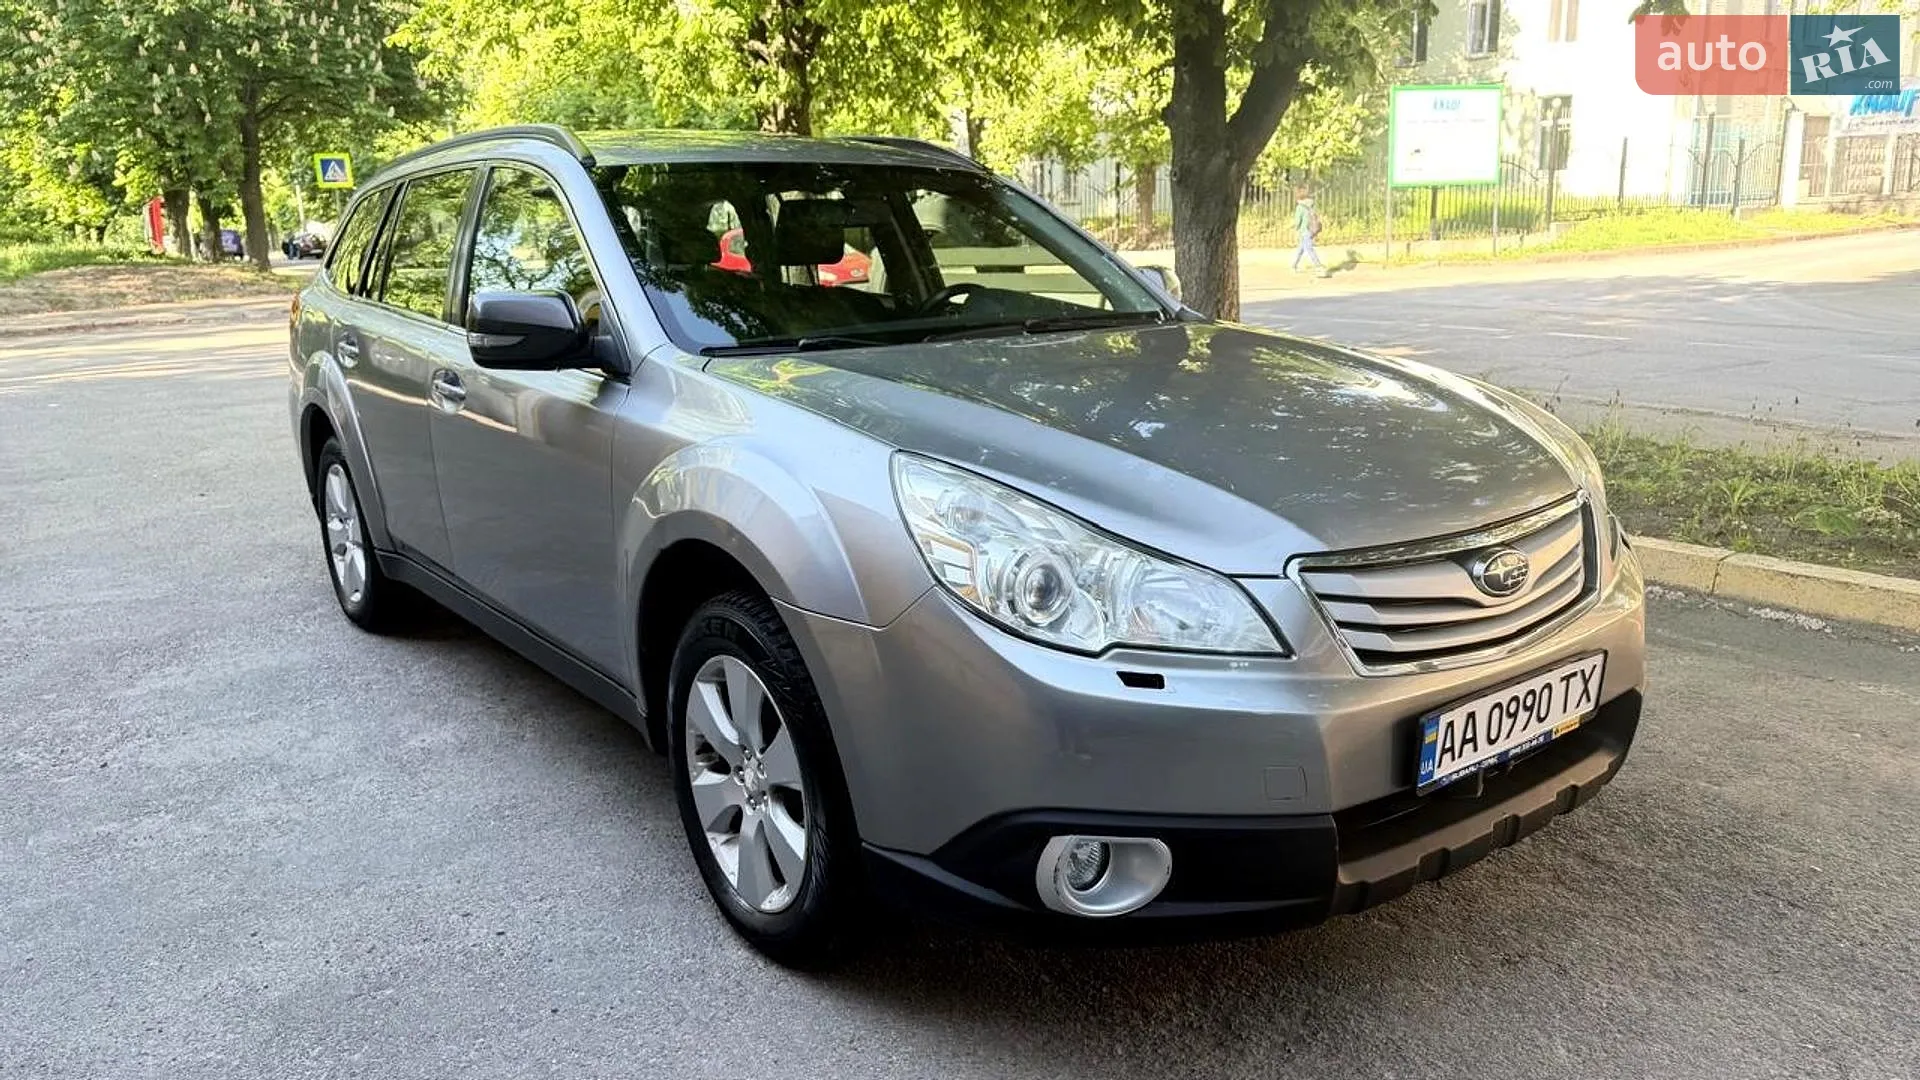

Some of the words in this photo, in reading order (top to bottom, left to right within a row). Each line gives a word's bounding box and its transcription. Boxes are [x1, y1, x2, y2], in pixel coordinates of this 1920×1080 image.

[1437, 710, 1479, 769] AA
[1486, 682, 1553, 746] 0990
[1560, 664, 1597, 714] TX
[1420, 759, 1434, 775] UA
